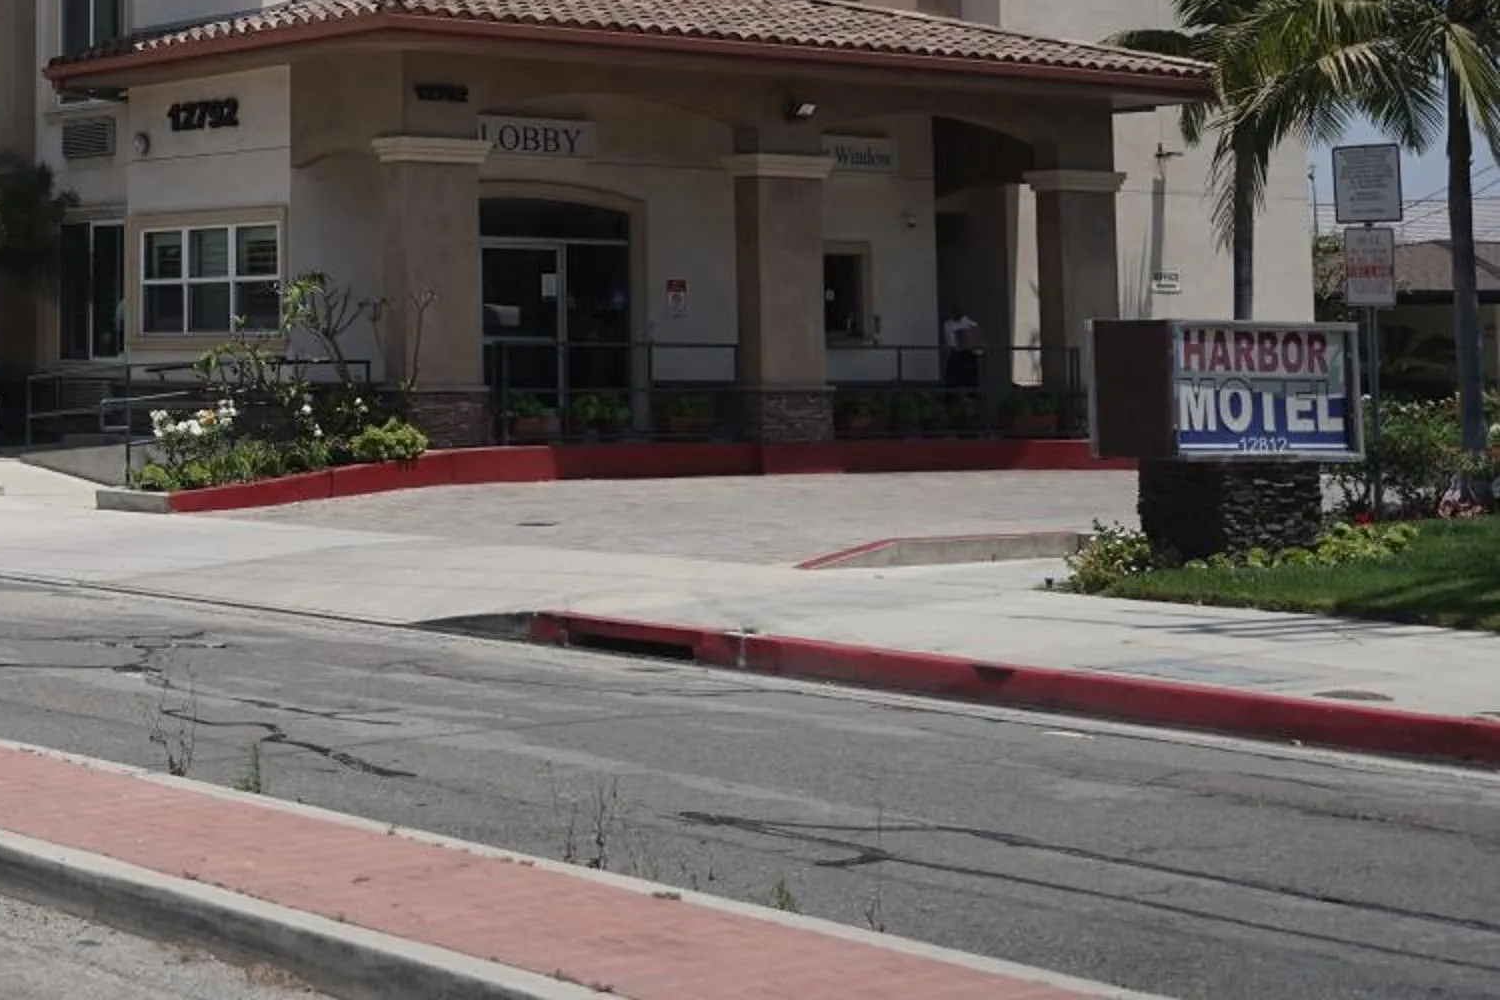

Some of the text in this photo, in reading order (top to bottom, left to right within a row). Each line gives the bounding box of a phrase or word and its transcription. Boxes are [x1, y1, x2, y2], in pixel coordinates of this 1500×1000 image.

[1182, 328, 1329, 374] HARBOR
[1178, 378, 1344, 432] MOTEL
[1238, 436, 1289, 454] 12812
